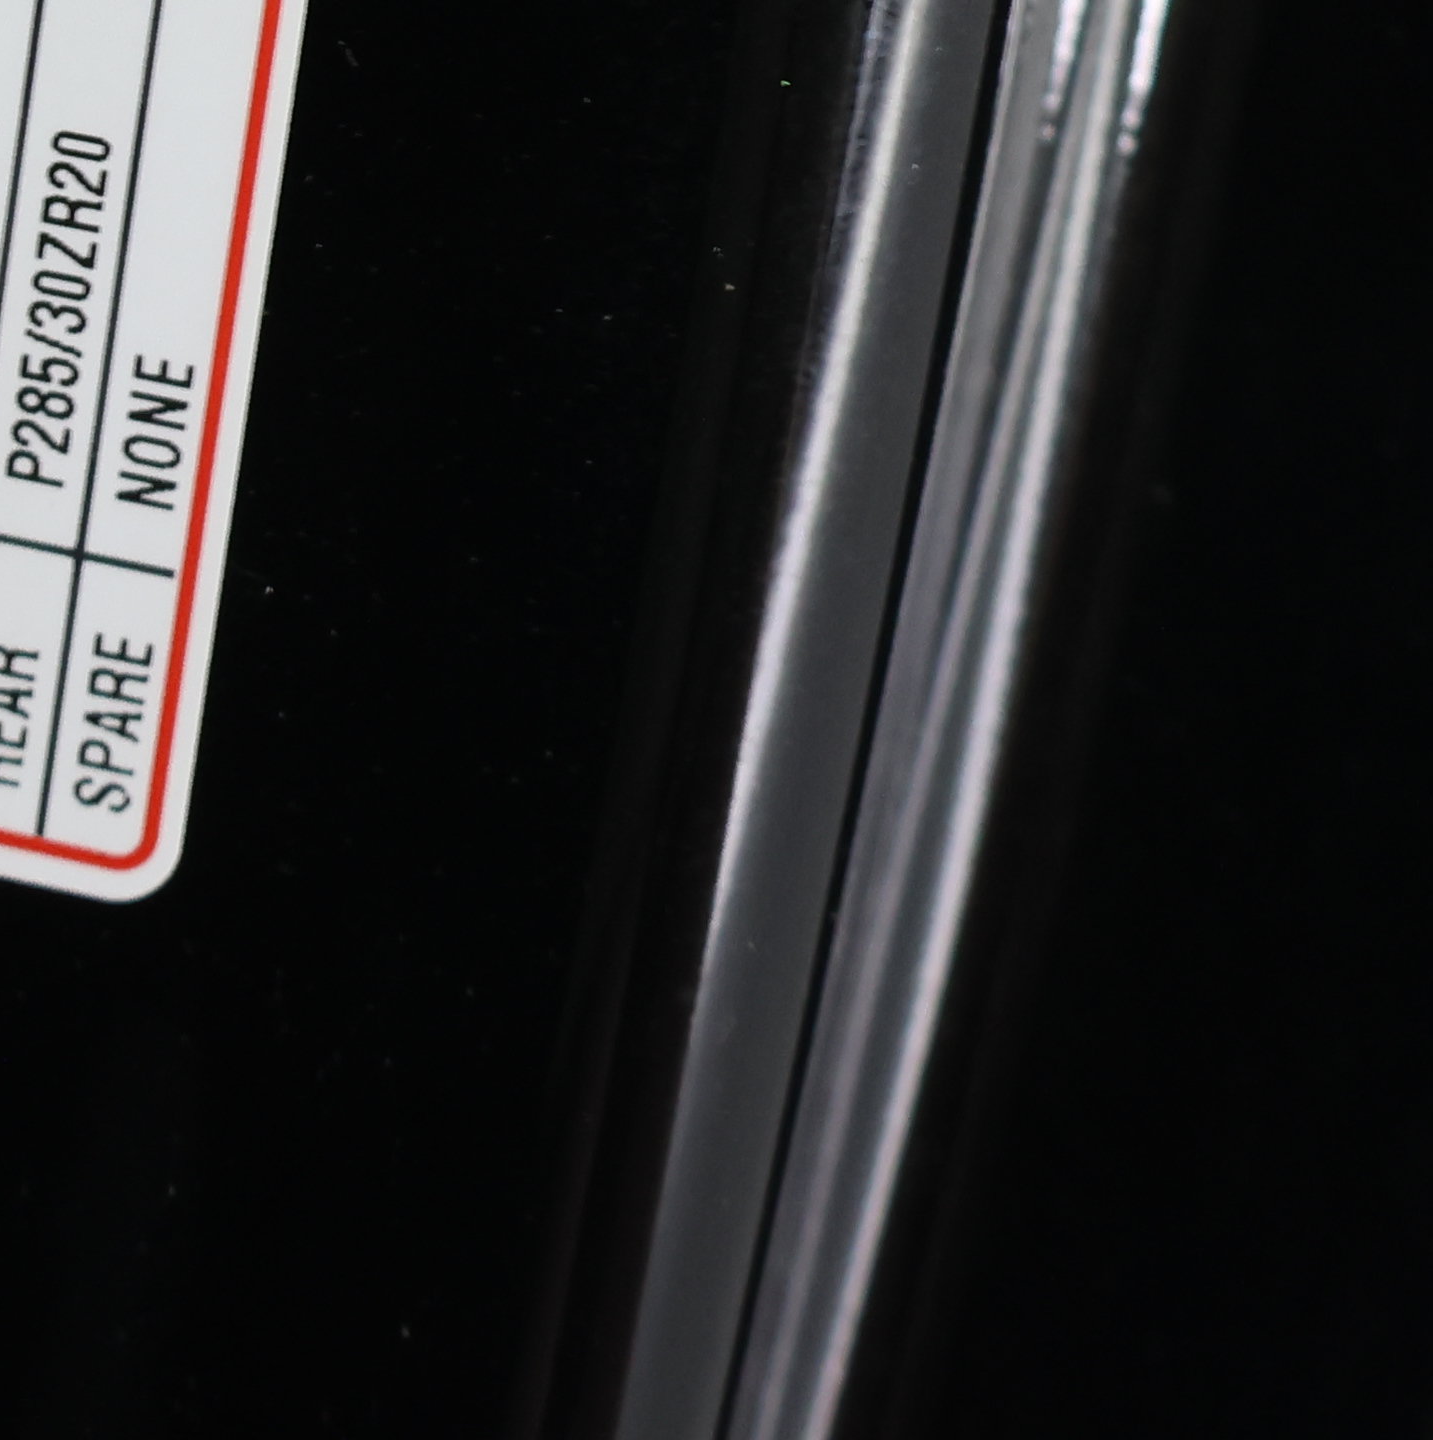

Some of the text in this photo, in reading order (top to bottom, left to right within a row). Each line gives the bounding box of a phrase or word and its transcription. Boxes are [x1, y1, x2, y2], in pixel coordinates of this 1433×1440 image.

[4, 129, 112, 489] P285/30ZR20
[114, 354, 195, 512] NONE
[72, 632, 154, 814] SPARE
